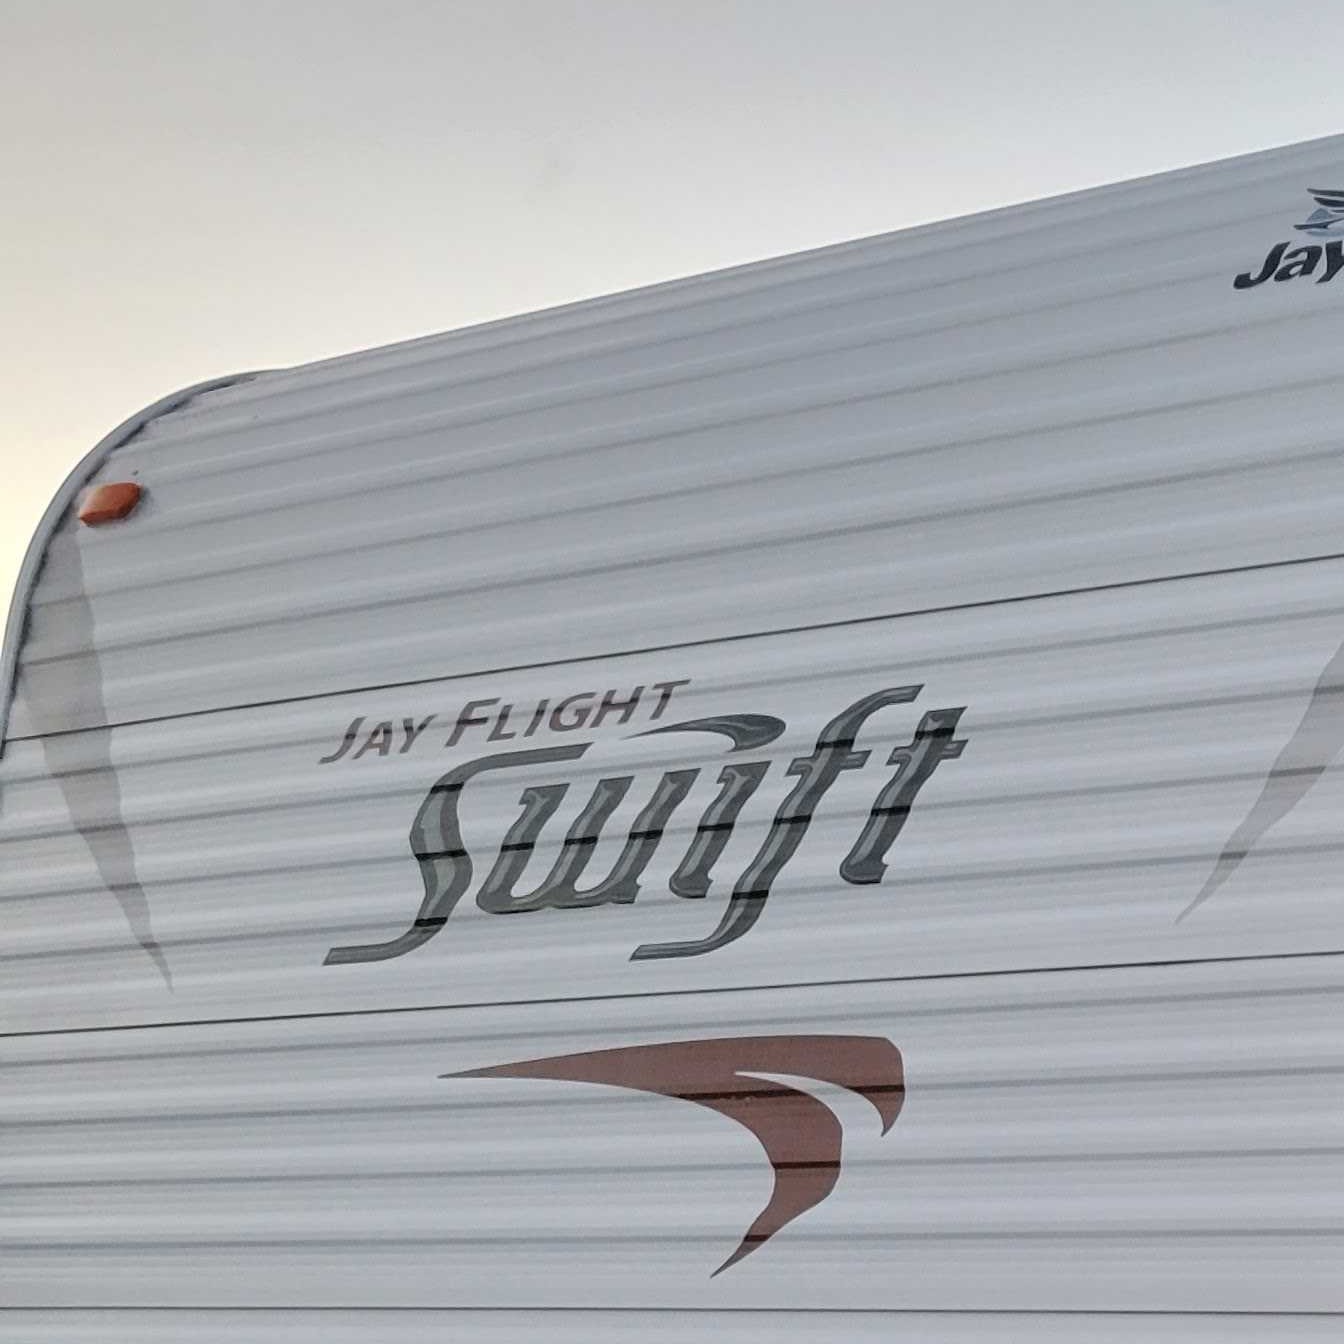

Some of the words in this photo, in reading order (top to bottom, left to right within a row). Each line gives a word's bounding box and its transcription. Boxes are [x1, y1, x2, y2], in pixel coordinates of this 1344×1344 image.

[318, 712, 438, 766] JAY
[444, 679, 692, 748] FLIGHT
[322, 683, 969, 967] Swift
